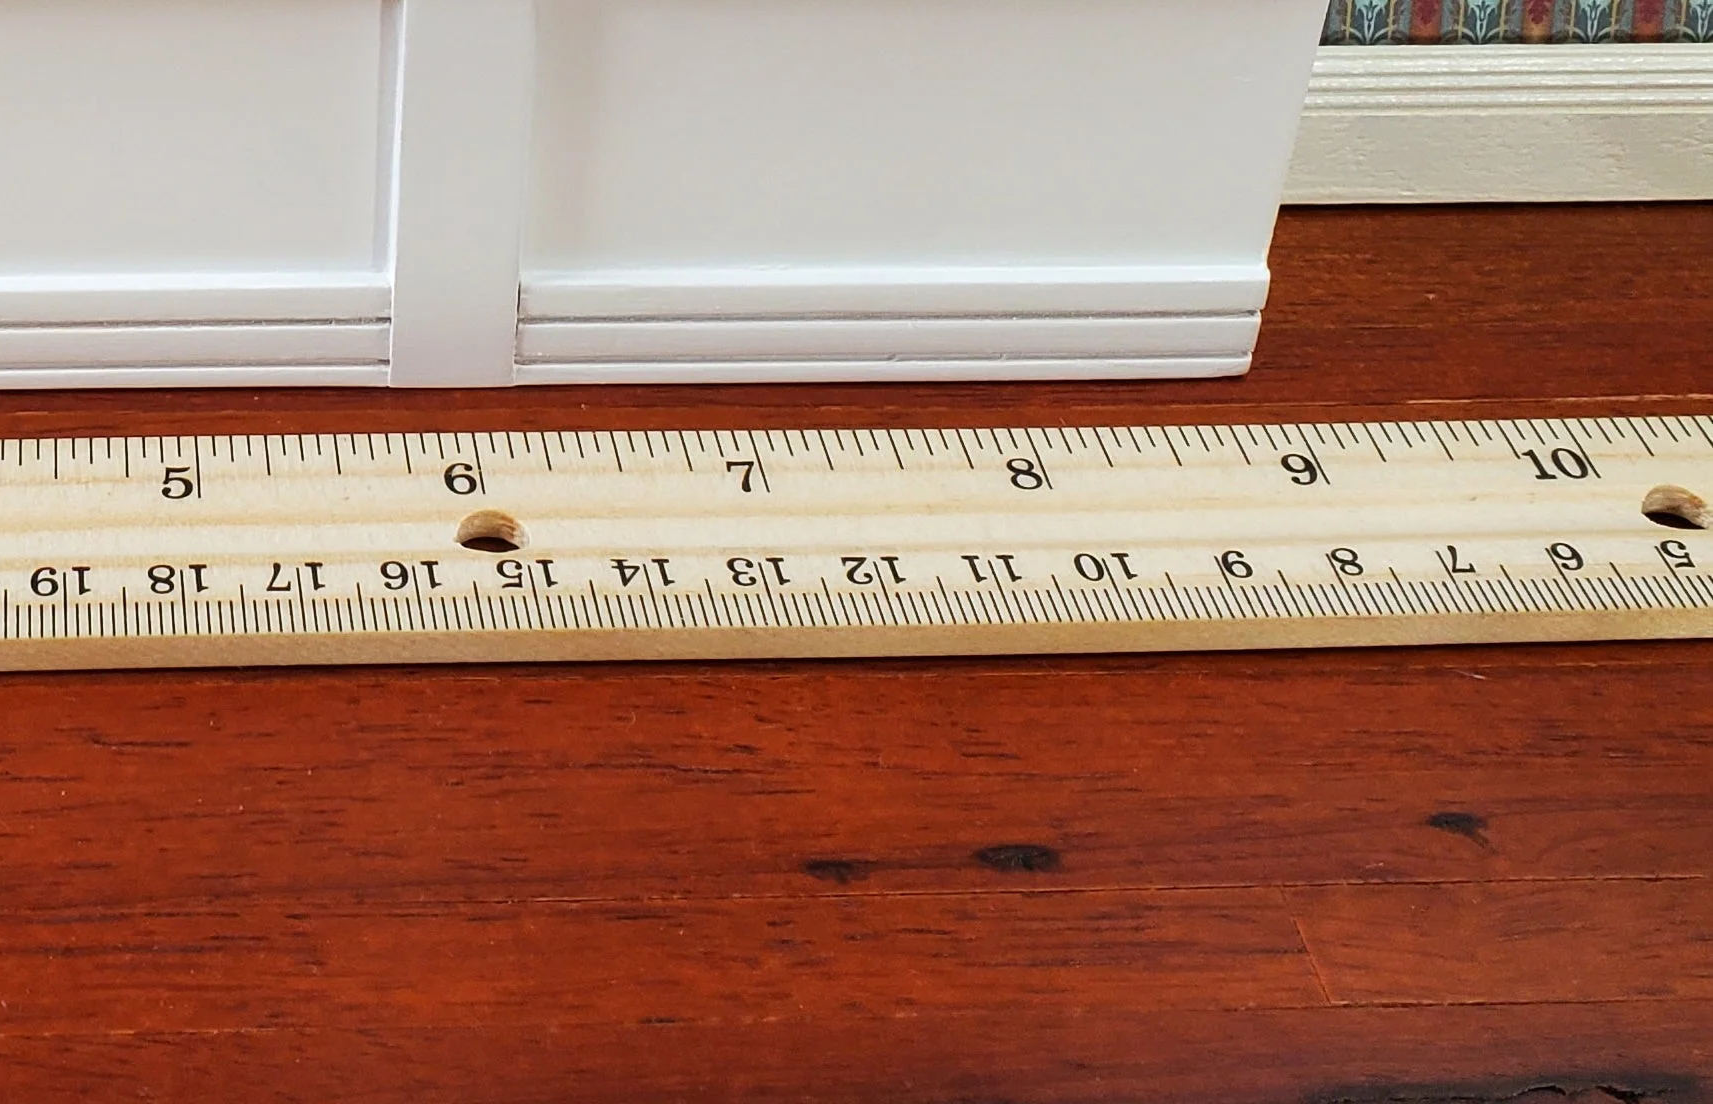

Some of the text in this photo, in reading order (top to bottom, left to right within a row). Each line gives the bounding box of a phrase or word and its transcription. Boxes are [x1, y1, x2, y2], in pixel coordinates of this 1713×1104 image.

[161, 467, 193, 499] 5
[444, 463, 477, 495] 6
[726, 460, 756, 493] 7
[1008, 458, 1042, 490] 8
[1280, 453, 1318, 485] 9
[1520, 448, 1589, 480] 10
[960, 554, 1024, 584] 11
[1074, 551, 1139, 582] 10
[1222, 549, 1254, 579] 9
[1331, 547, 1364, 577] 8
[1442, 544, 1476, 574] 7
[1550, 542, 1584, 571] 6
[1660, 539, 1696, 569] 5
[30, 566, 92, 597] 19
[148, 563, 208, 594] 18
[265, 562, 326, 592] 17
[379, 560, 442, 591] 16
[496, 558, 559, 588] 15
[611, 558, 675, 586] 14
[726, 556, 791, 586] 13
[841, 555, 906, 585] 12
